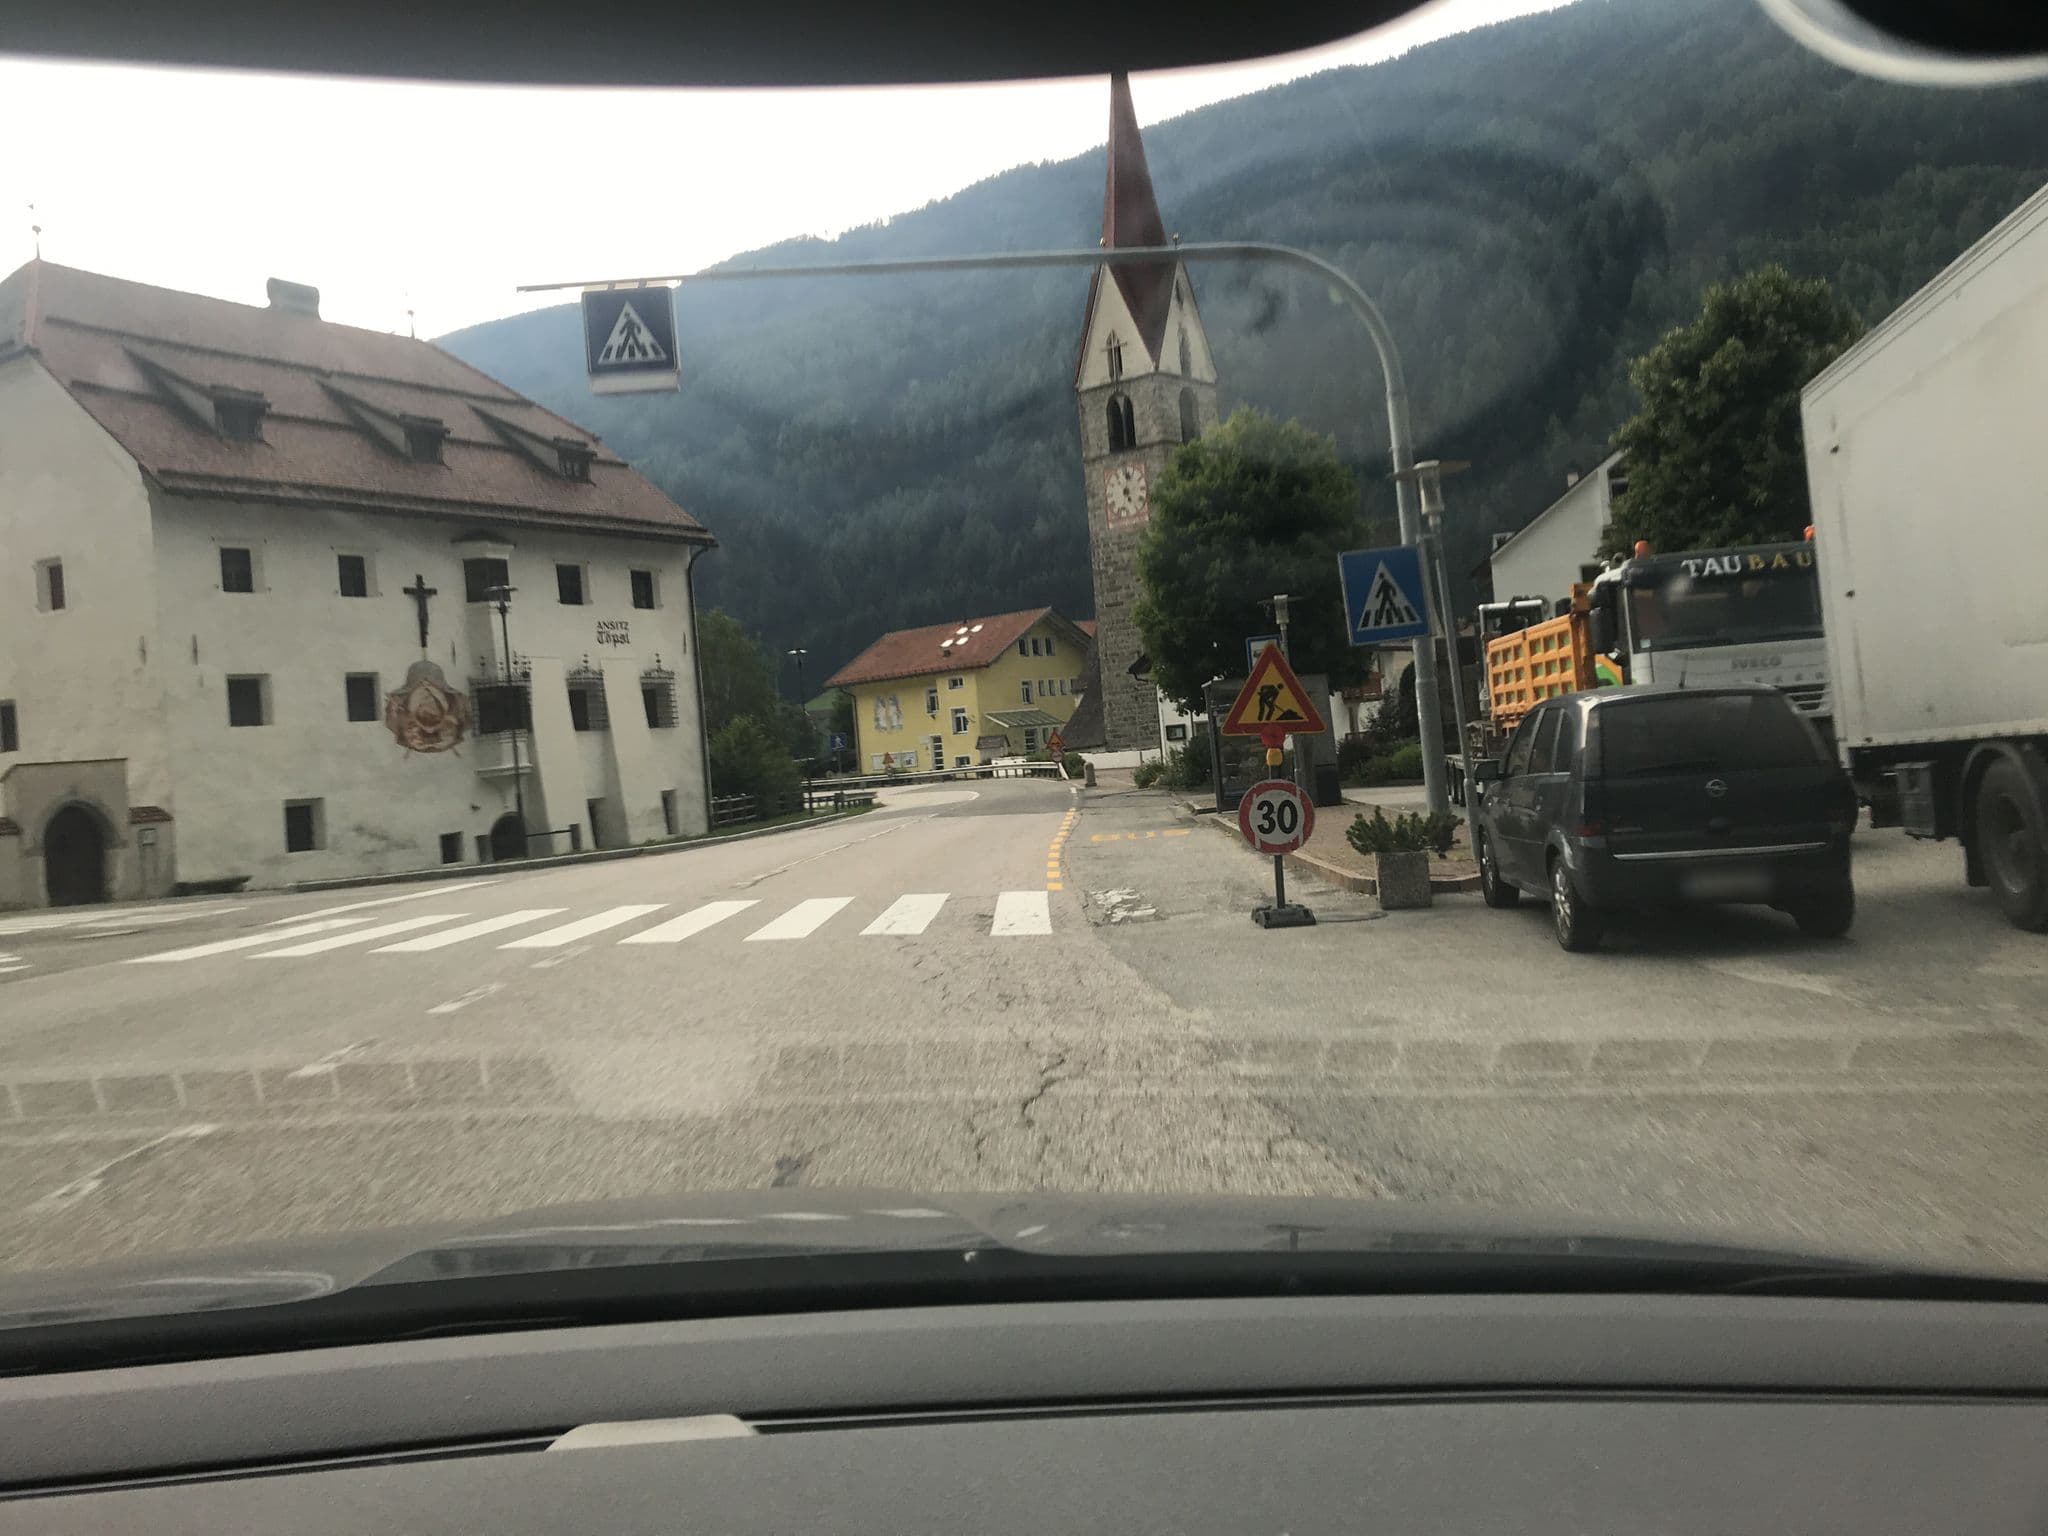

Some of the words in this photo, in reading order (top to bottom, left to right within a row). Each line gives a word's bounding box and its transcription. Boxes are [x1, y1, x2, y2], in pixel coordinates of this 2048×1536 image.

[597, 621, 629, 630] ANSITZ
[1731, 656, 1781, 669] IVECO
[1257, 799, 1298, 834] 30
